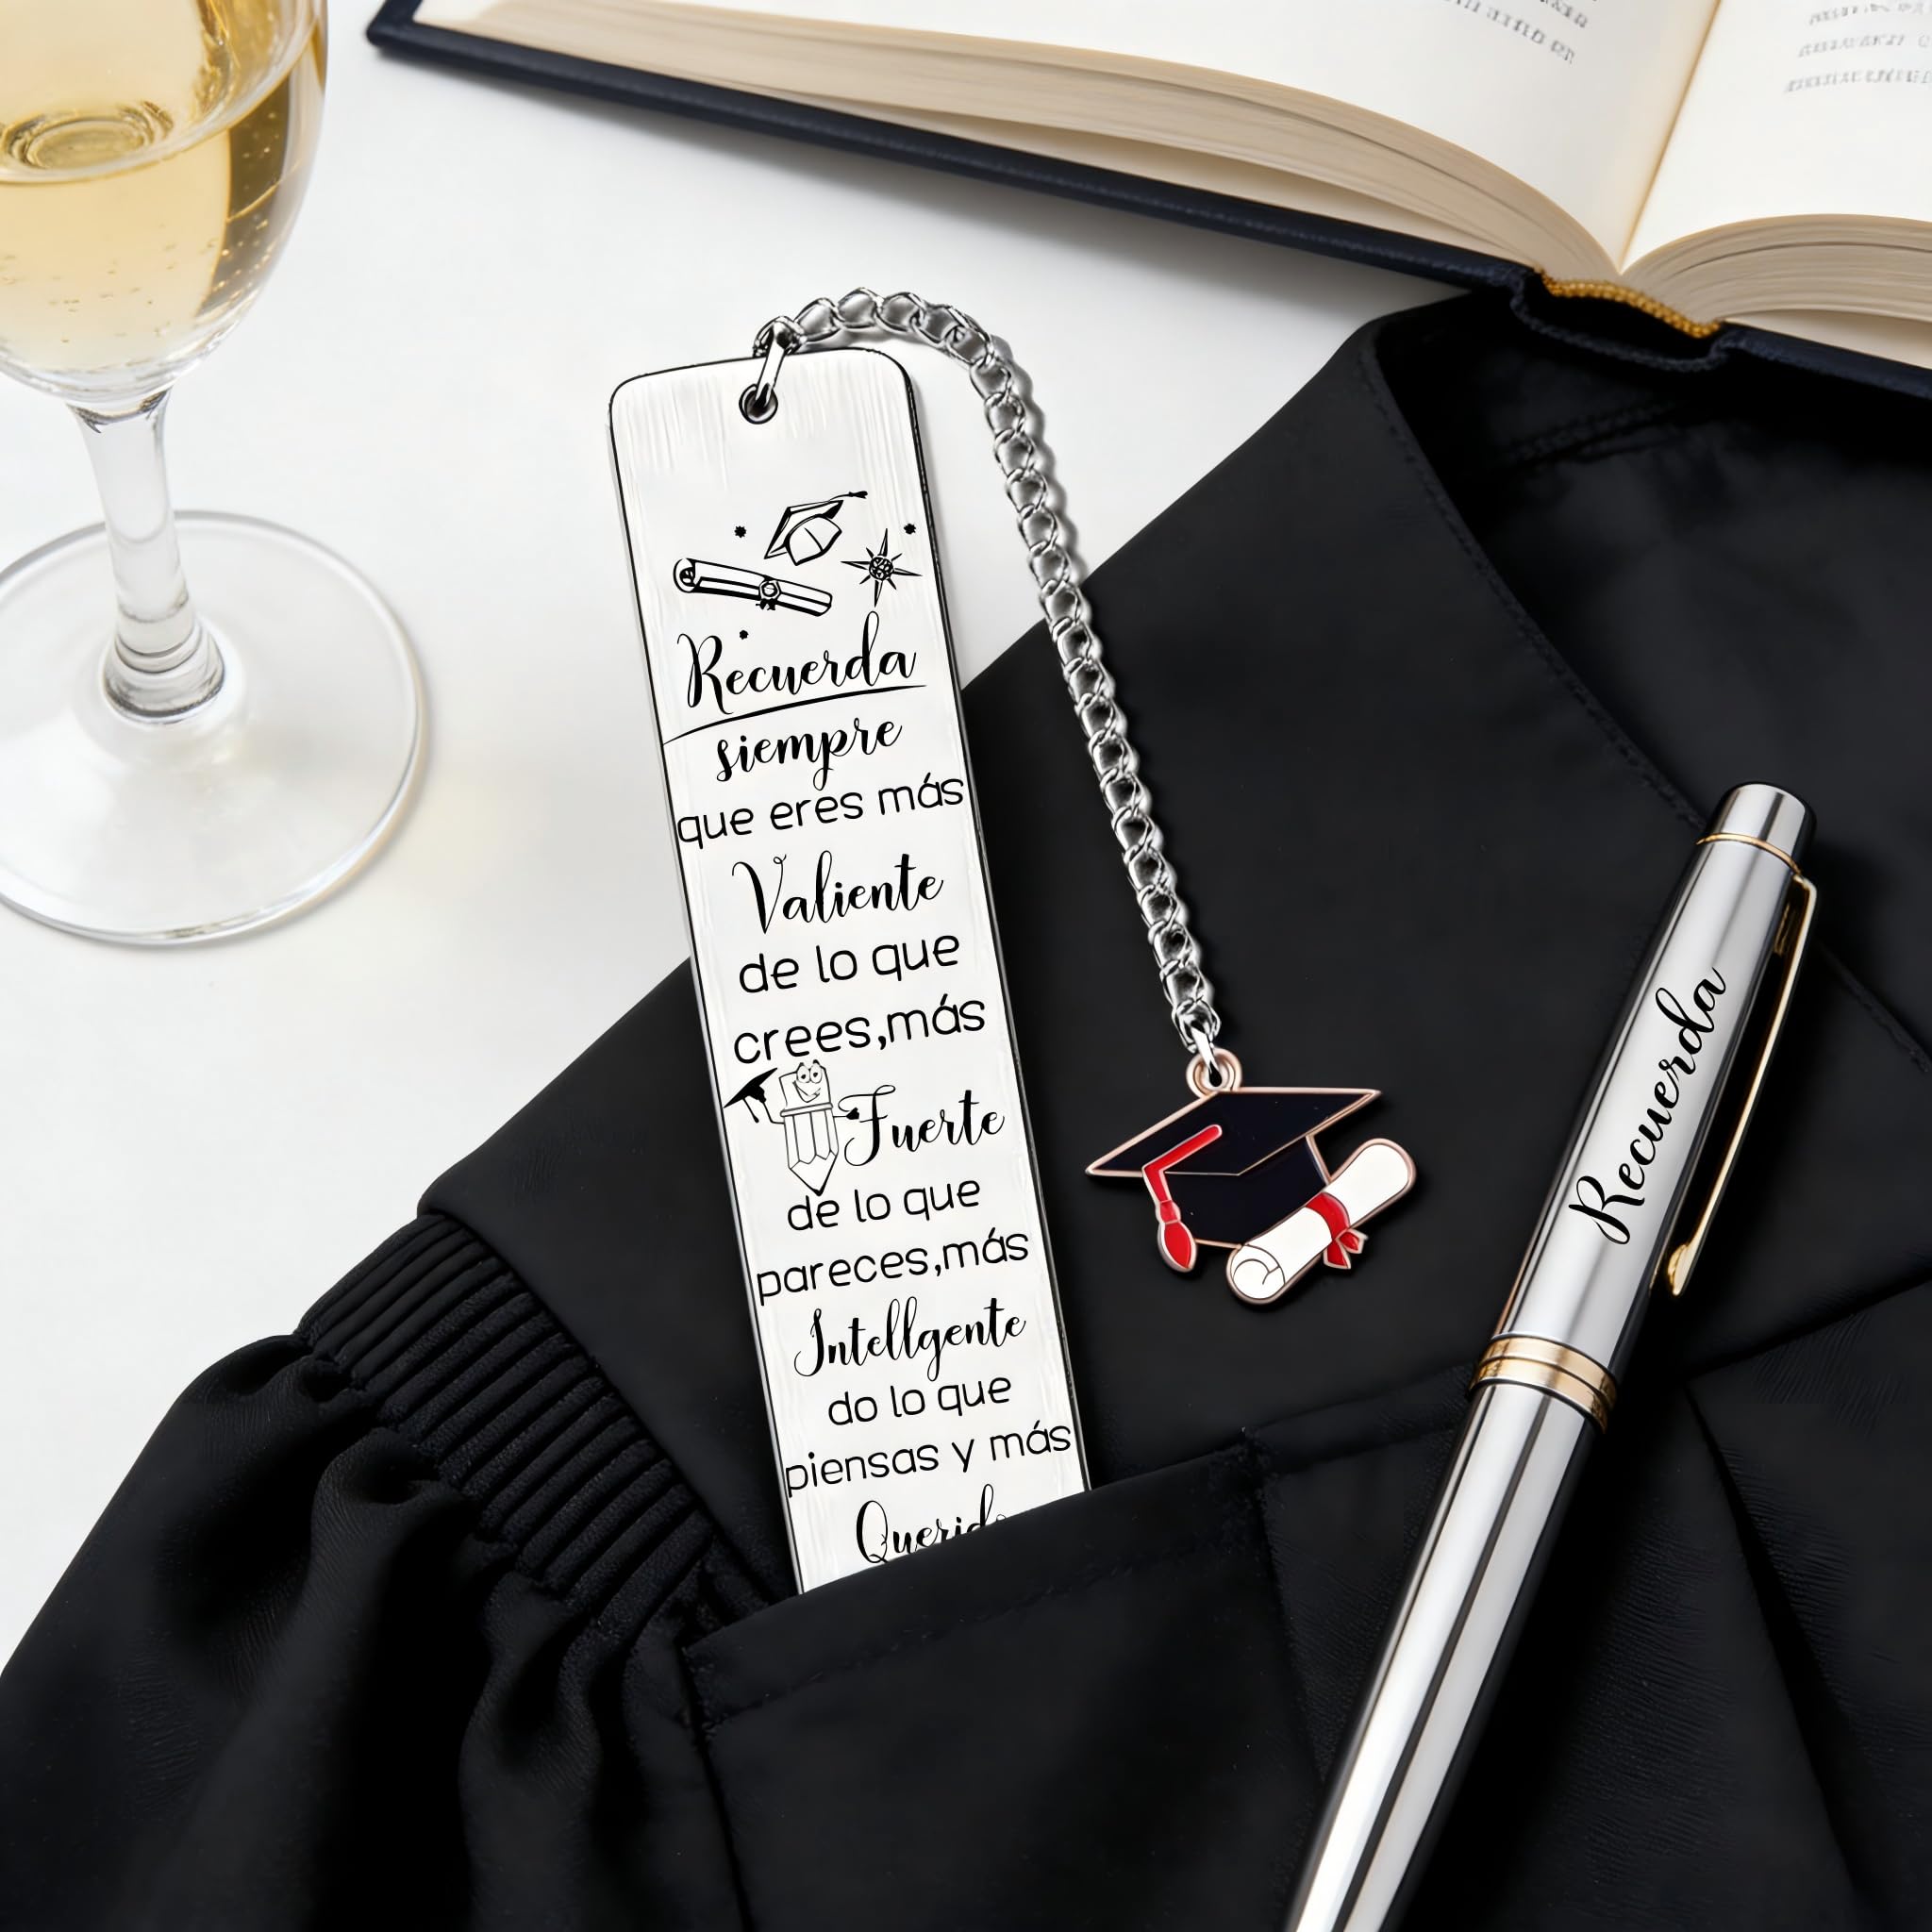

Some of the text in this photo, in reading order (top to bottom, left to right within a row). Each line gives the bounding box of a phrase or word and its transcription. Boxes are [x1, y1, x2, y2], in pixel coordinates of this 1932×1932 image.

[677, 610, 916, 714] Recuerda
[716, 718, 903, 791] siempre
[677, 772, 963, 849] que eres más
[732, 850, 943, 934] Valiente
[739, 935, 959, 992] de lo que
[838, 1085, 1005, 1166] Fuerte
[1568, 967, 1726, 1244] Recuerda
[787, 1180, 980, 1230] de lo que
[828, 1376, 1011, 1425] do lo que
[785, 1420, 1072, 1498] piensas y más
[857, 1484, 1008, 1563] Querid
